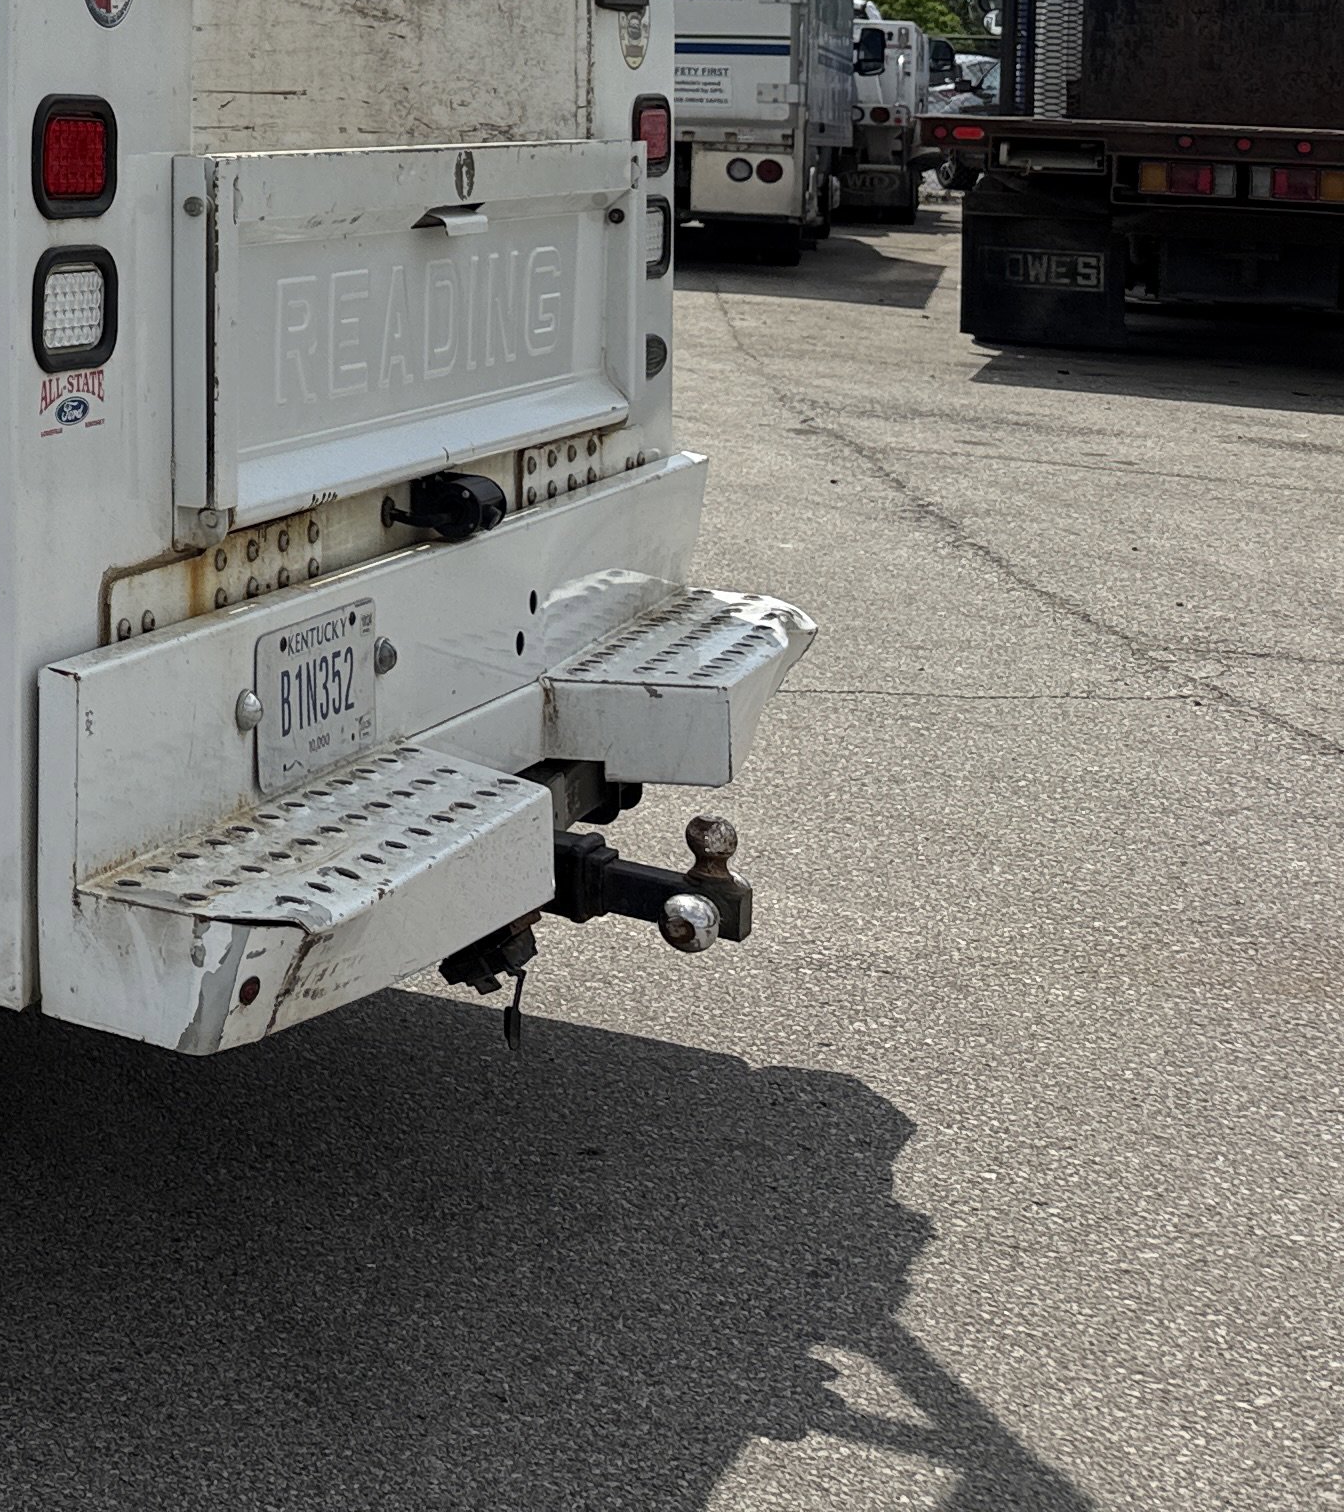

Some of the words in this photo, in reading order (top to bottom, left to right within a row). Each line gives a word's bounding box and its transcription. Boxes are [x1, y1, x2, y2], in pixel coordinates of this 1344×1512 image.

[674, 67, 699, 77] FETY
[701, 67, 729, 77] FIRST
[275, 245, 563, 406] READING
[60, 400, 85, 422] Ford
[287, 616, 348, 656] KENTUCKY
[280, 646, 355, 738] B1N352
